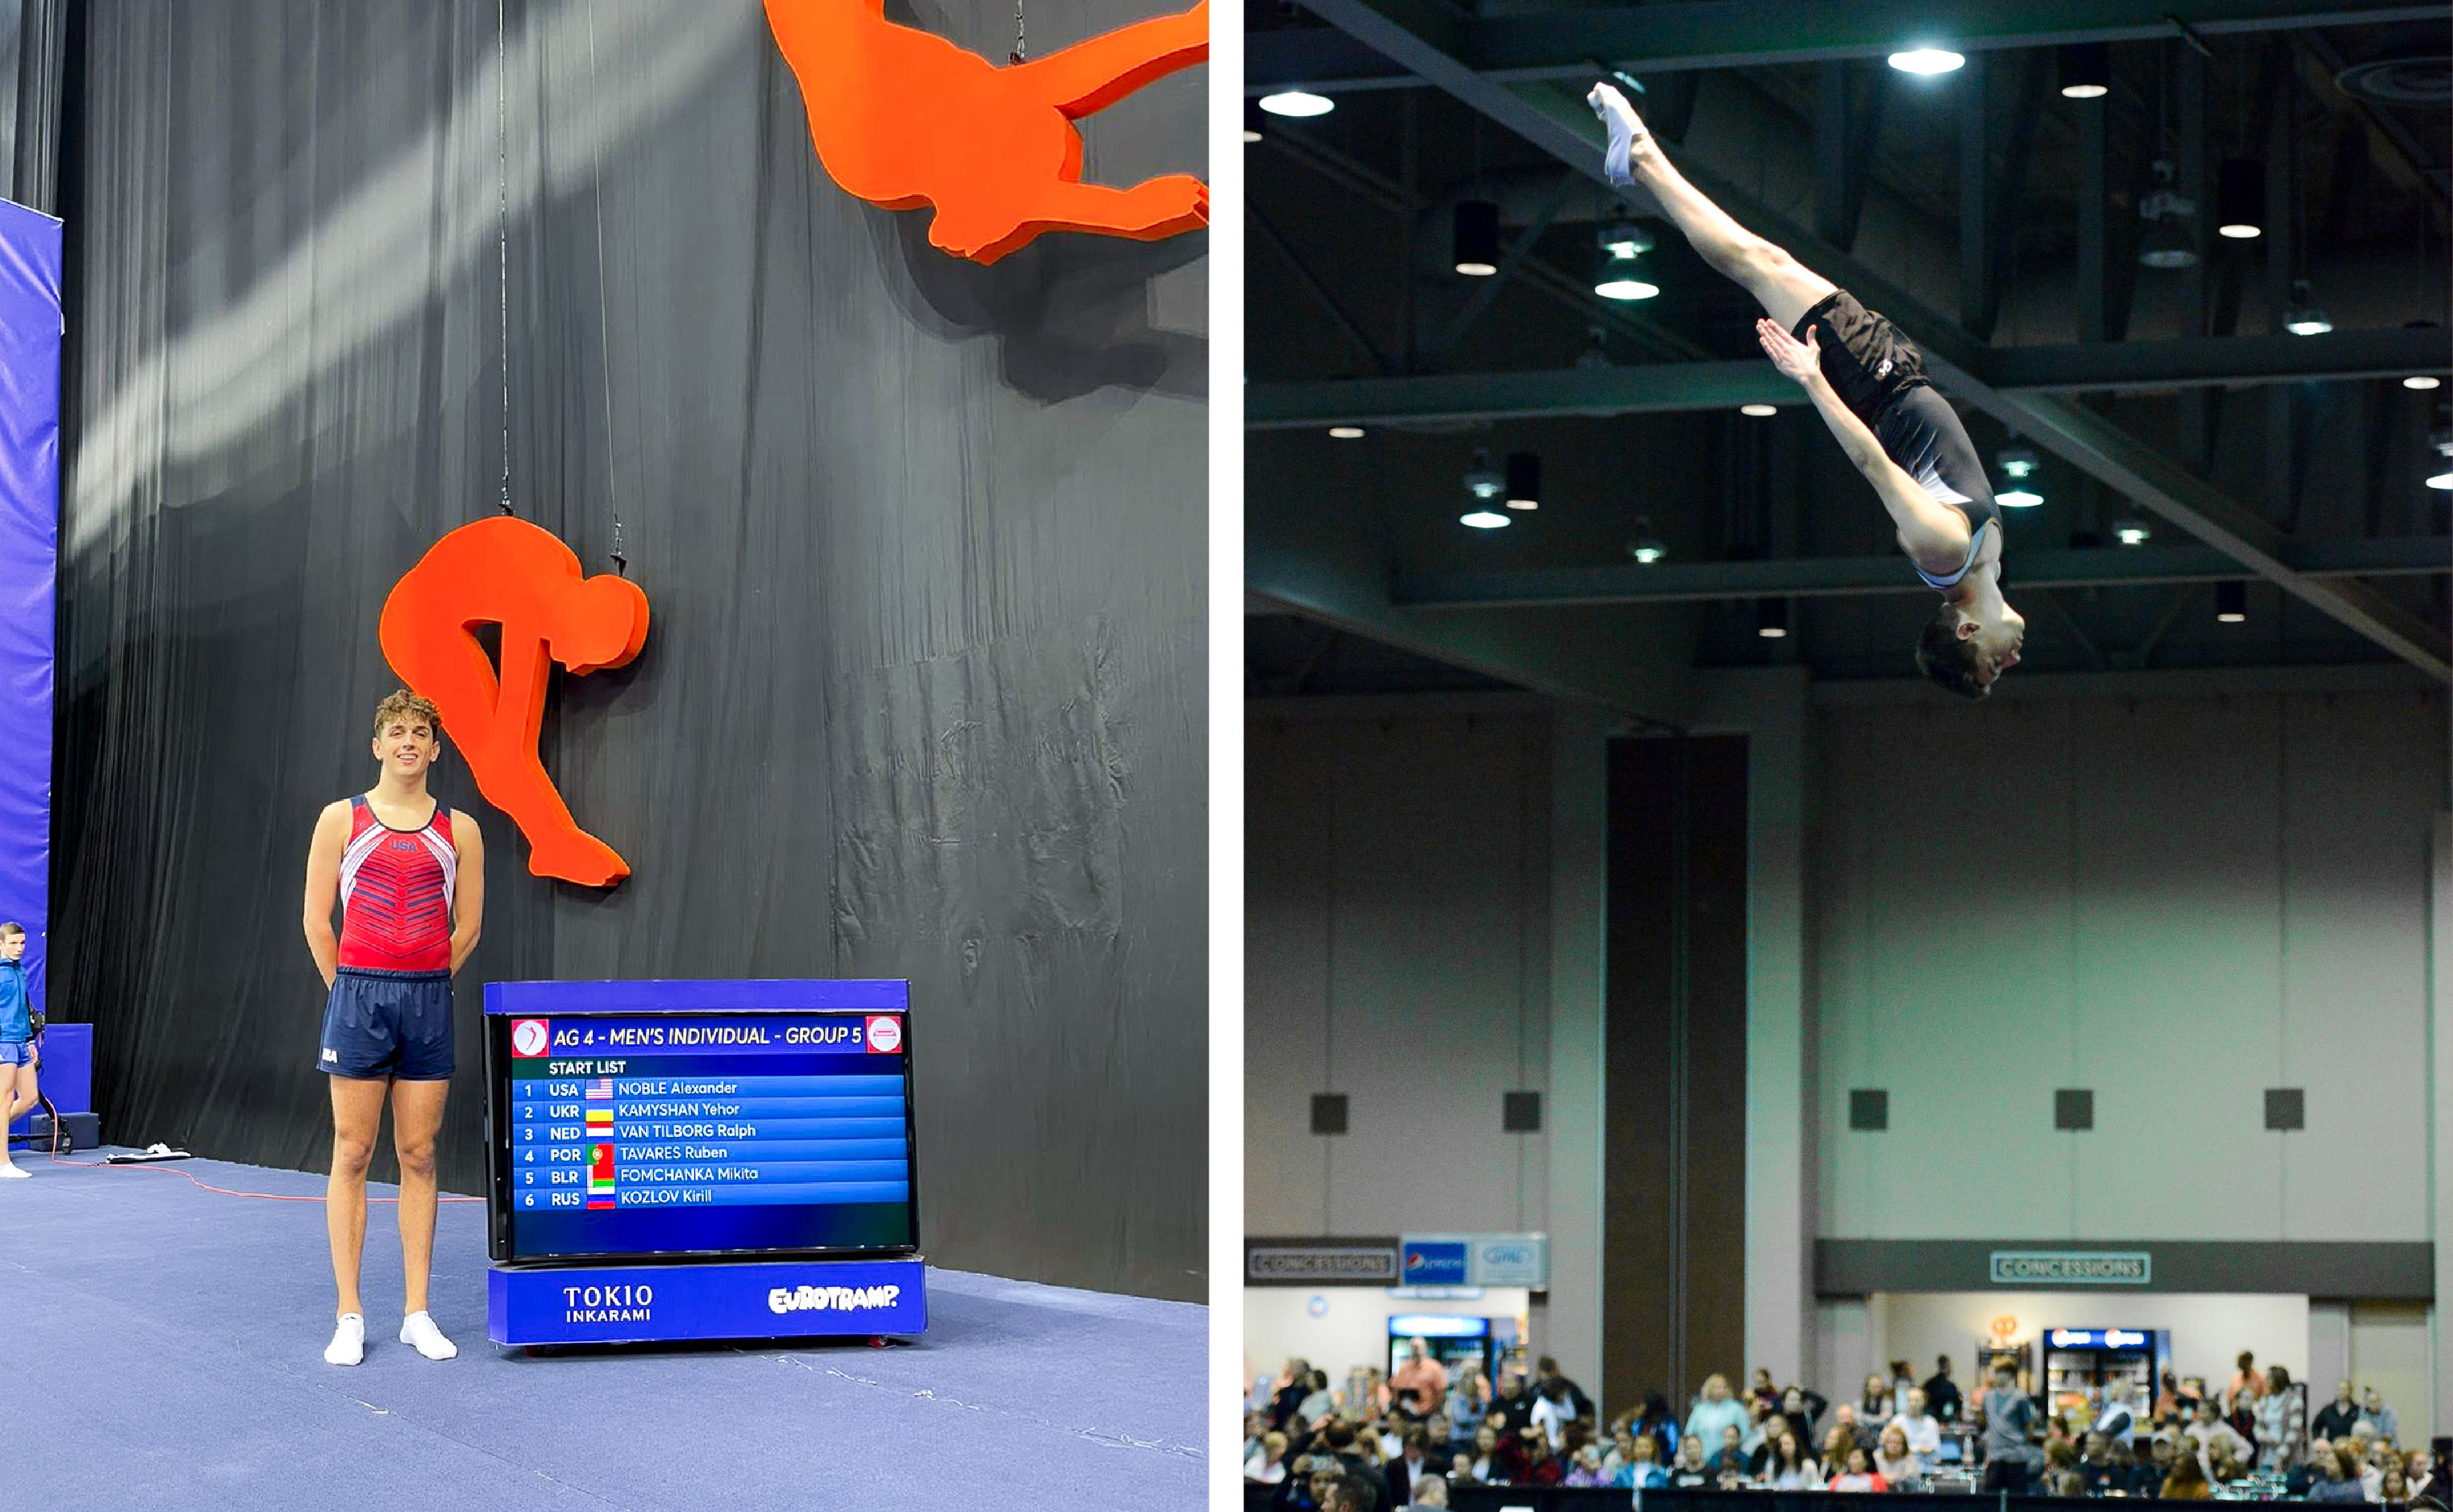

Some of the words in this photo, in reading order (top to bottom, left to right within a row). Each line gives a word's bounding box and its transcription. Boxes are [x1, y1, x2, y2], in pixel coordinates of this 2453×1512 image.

[391, 840, 417, 852] USA
[553, 1030, 579, 1046] AG
[583, 1030, 594, 1046] 4
[610, 1027, 664, 1045] MEN'S
[668, 1027, 770, 1045] INDIVIDUAL
[785, 1027, 848, 1044] GROUP
[852, 1027, 861, 1043] 5
[549, 1061, 593, 1075] START
[597, 1060, 626, 1074] LIST
[525, 1085, 531, 1097] 1
[550, 1084, 579, 1097] USA
[618, 1082, 668, 1096] NOBLE
[671, 1081, 738, 1094] Alexander
[525, 1106, 533, 1118] 2
[550, 1105, 579, 1118] UKR
[618, 1103, 699, 1117] KAMYSHAN
[702, 1102, 740, 1116] Yehor
[525, 1128, 533, 1140] 3
[550, 1127, 581, 1140] NED
[619, 1125, 650, 1138] VAN
[653, 1124, 714, 1138] TILBORG
[718, 1123, 756, 1139] Ralph
[525, 1150, 534, 1162] 4
[550, 1148, 581, 1161] POR
[620, 1147, 681, 1160] TAVARES
[685, 1146, 727, 1159] Ruben
[525, 1172, 534, 1184] 5
[552, 1171, 579, 1183] BLR
[621, 1168, 714, 1182] FOMCHANKA
[718, 1168, 759, 1181] Mikita
[525, 1193, 535, 1206] 6
[552, 1193, 580, 1206] RUS
[621, 1190, 679, 1204] KOZLOV
[683, 1189, 712, 1203] Kirill
[1998, 1258, 2142, 1277] CONCESSIONS
[564, 1285, 653, 1307] TOKIO
[566, 1309, 651, 1322] INKARAMI
